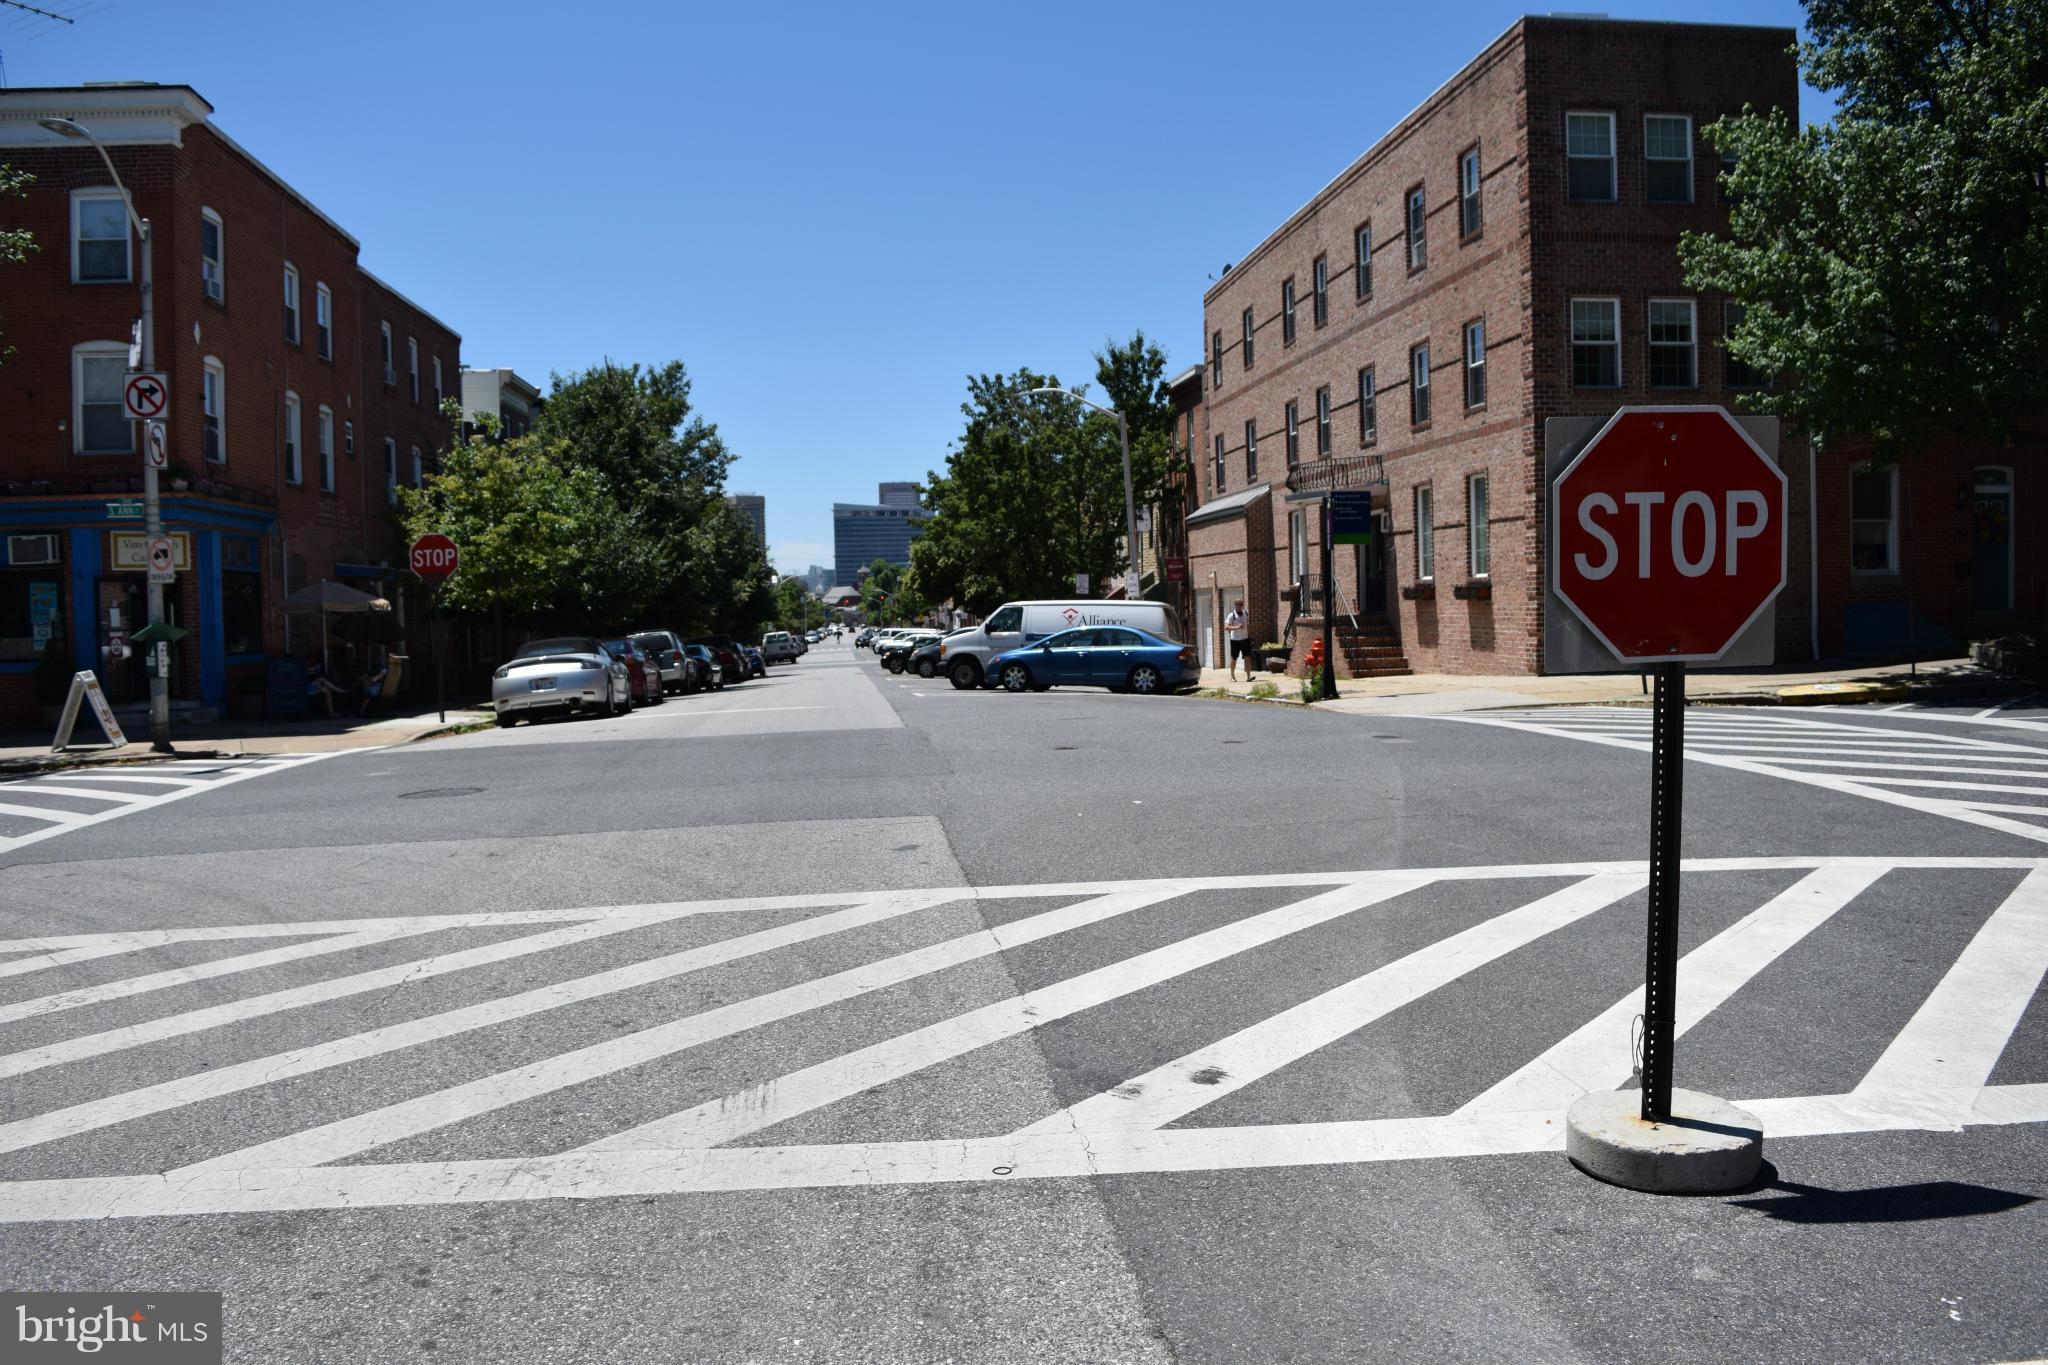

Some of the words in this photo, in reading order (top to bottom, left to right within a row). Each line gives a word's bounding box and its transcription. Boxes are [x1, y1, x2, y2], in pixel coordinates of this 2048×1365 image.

[1573, 489, 1769, 581] STOP
[123, 539, 143, 549] Van
[414, 548, 455, 567] STOP
[1078, 614, 1127, 626] Alliance
